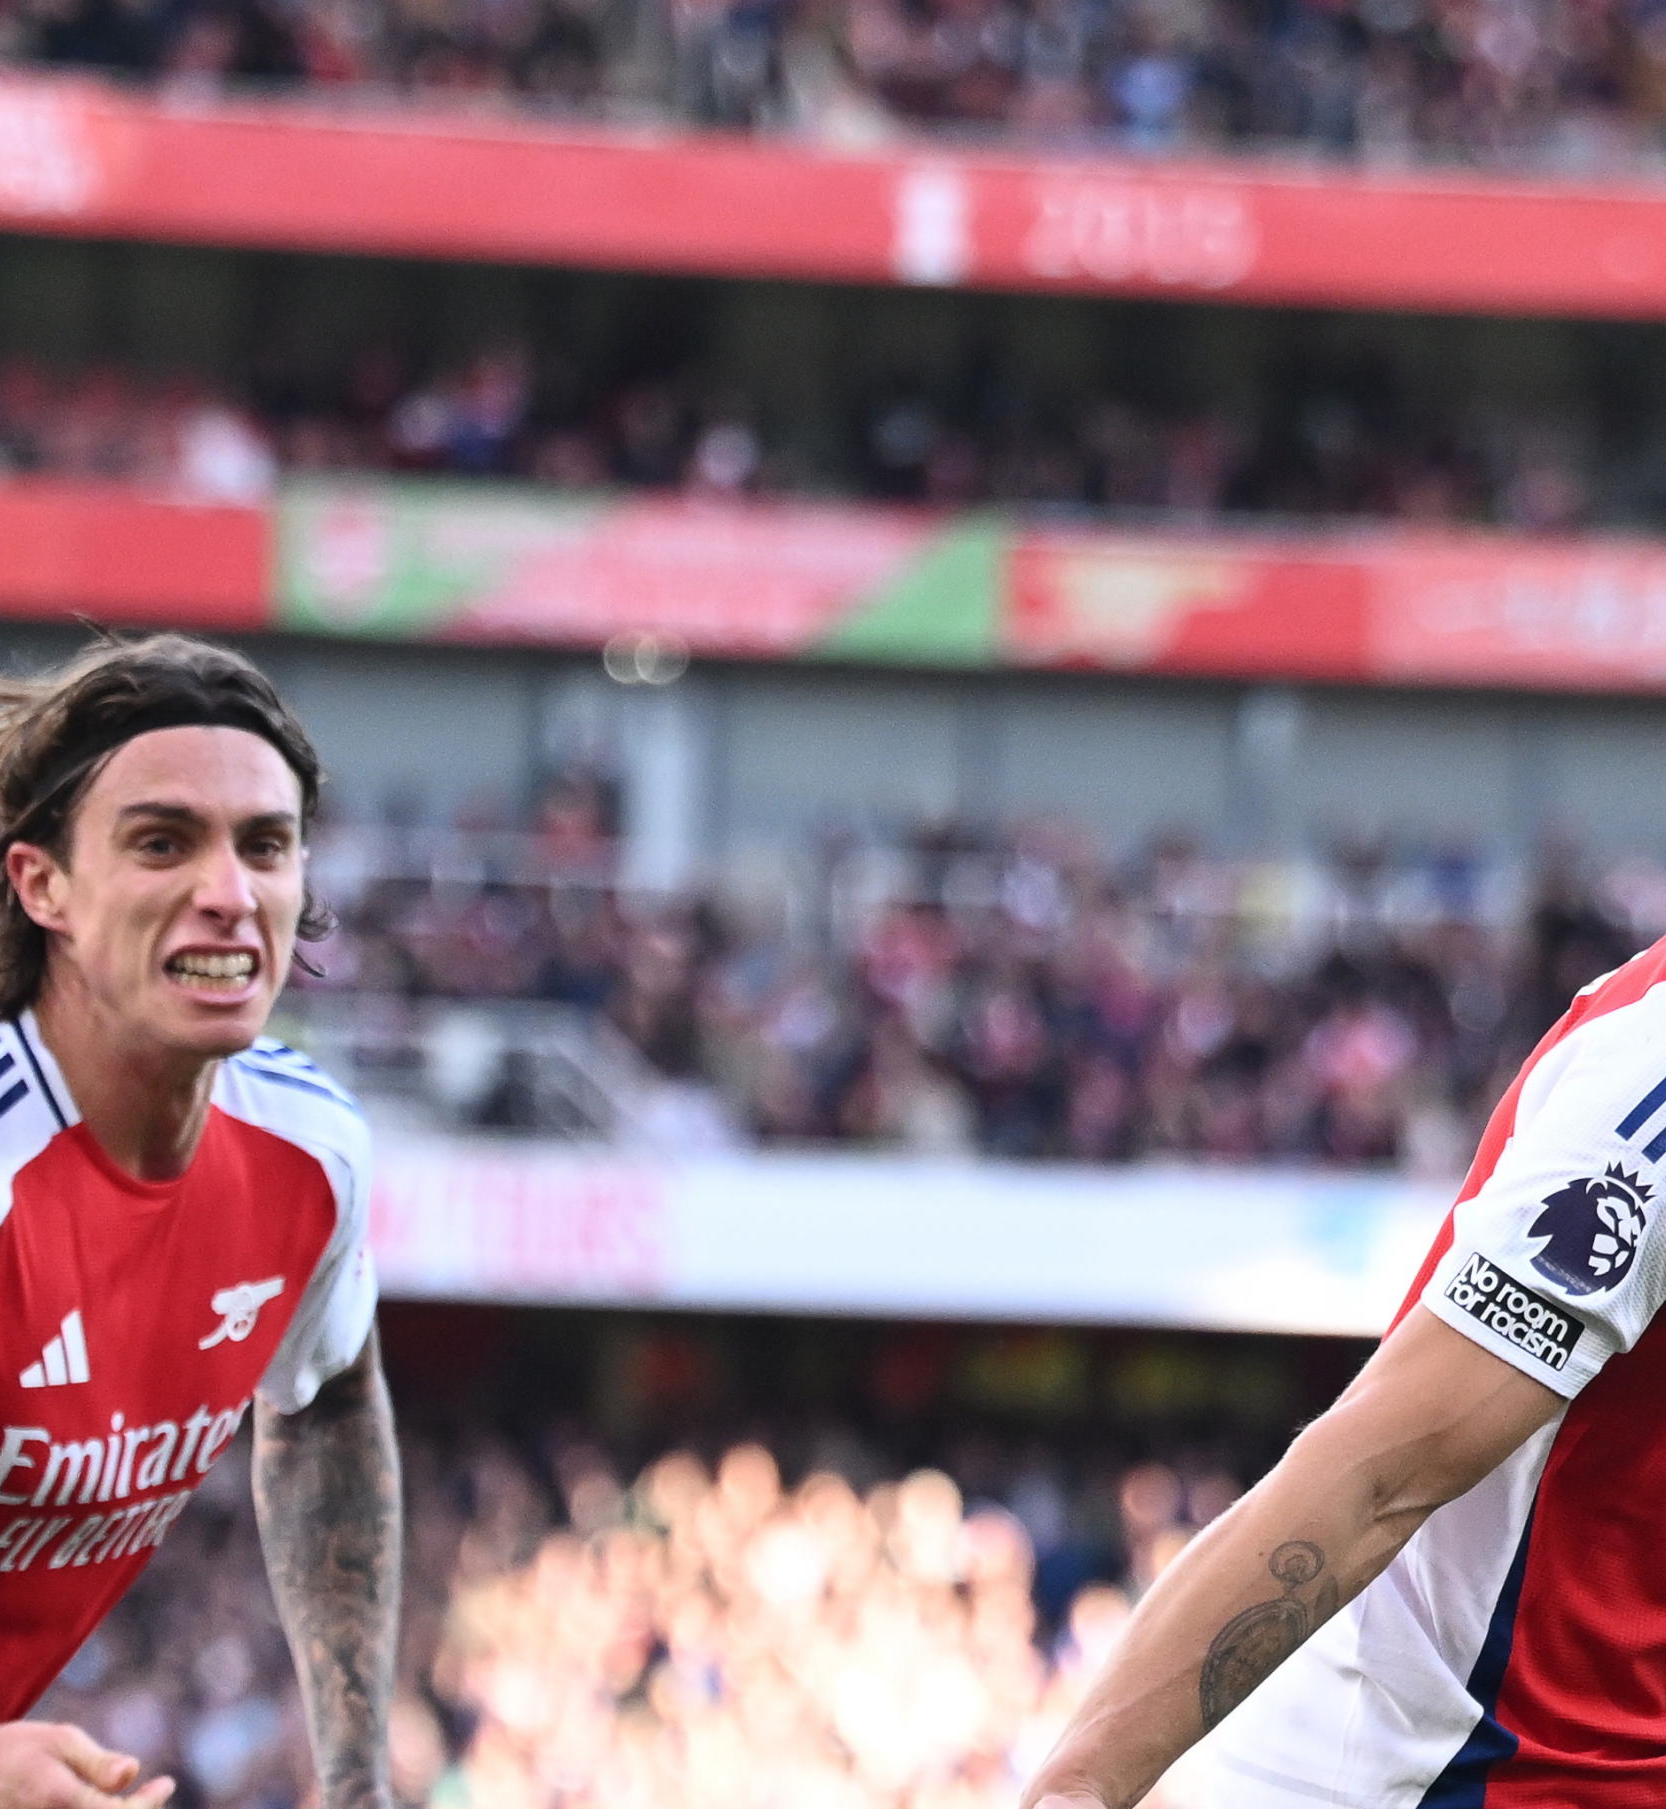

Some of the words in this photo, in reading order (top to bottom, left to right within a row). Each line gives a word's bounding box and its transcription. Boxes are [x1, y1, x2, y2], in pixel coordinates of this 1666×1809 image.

[1445, 1275, 1486, 1312] for
[1480, 1302, 1568, 1370] racism
[1463, 1253, 1499, 1293] No
[1495, 1282, 1568, 1343] room
